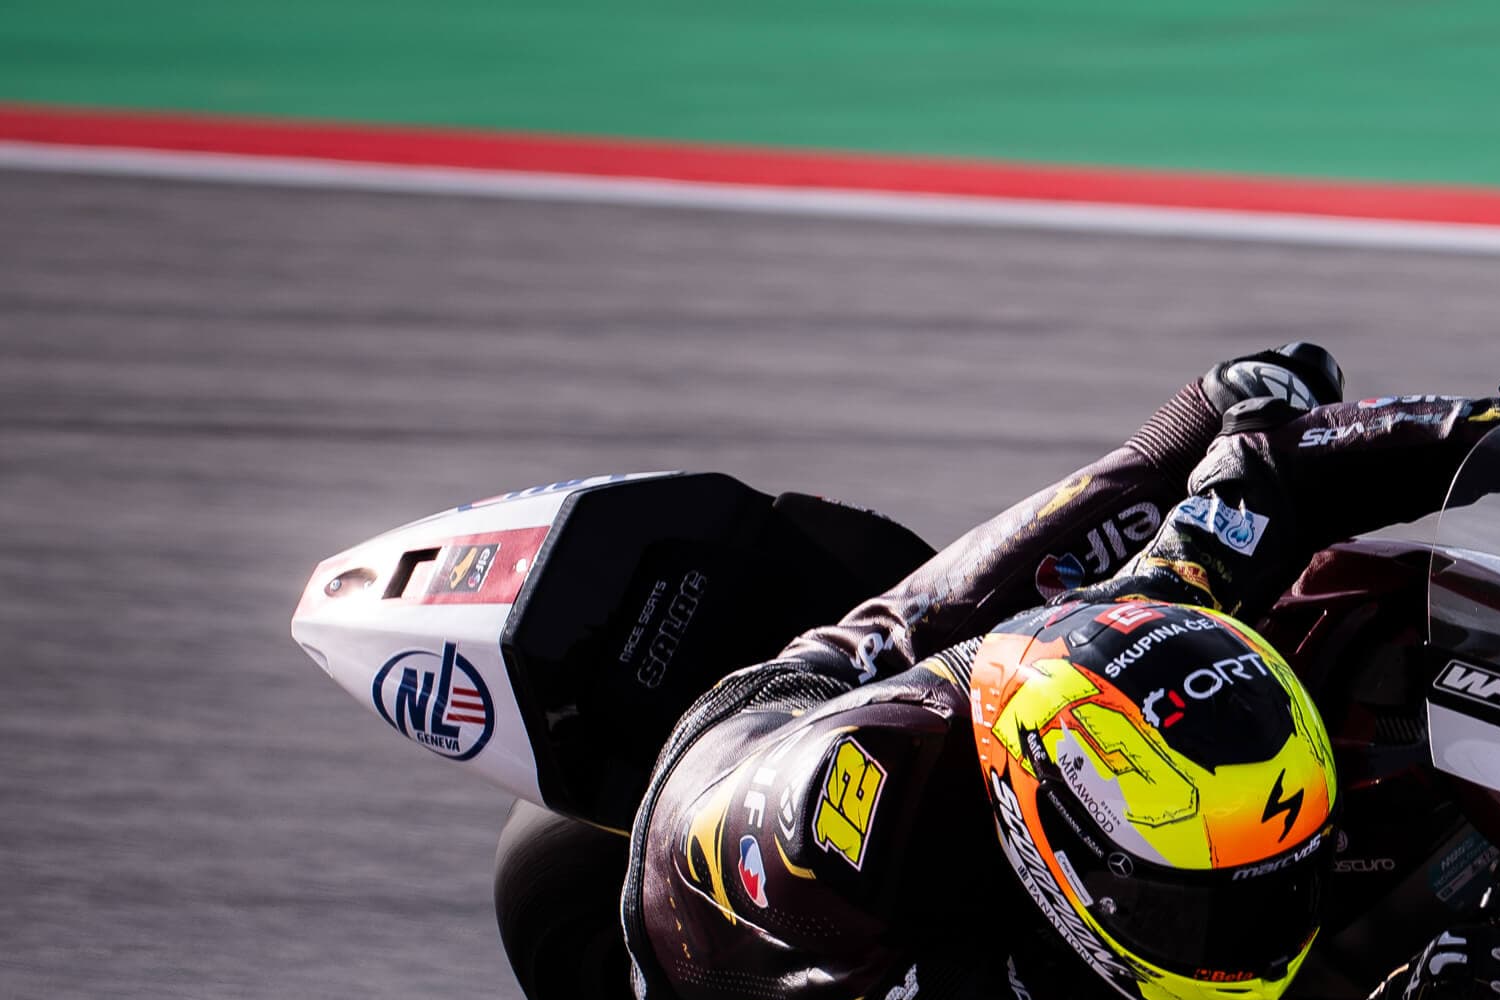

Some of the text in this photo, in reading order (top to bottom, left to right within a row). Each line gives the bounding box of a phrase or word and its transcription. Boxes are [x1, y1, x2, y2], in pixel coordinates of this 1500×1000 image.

[1084, 500, 1161, 576] elf
[1104, 623, 1187, 679] SKUPINA
[416, 730, 461, 753] GENEVA
[813, 737, 887, 870] 12
[1058, 752, 1114, 834] MIRAWOOD
[1027, 879, 1097, 968] PANATTONI
